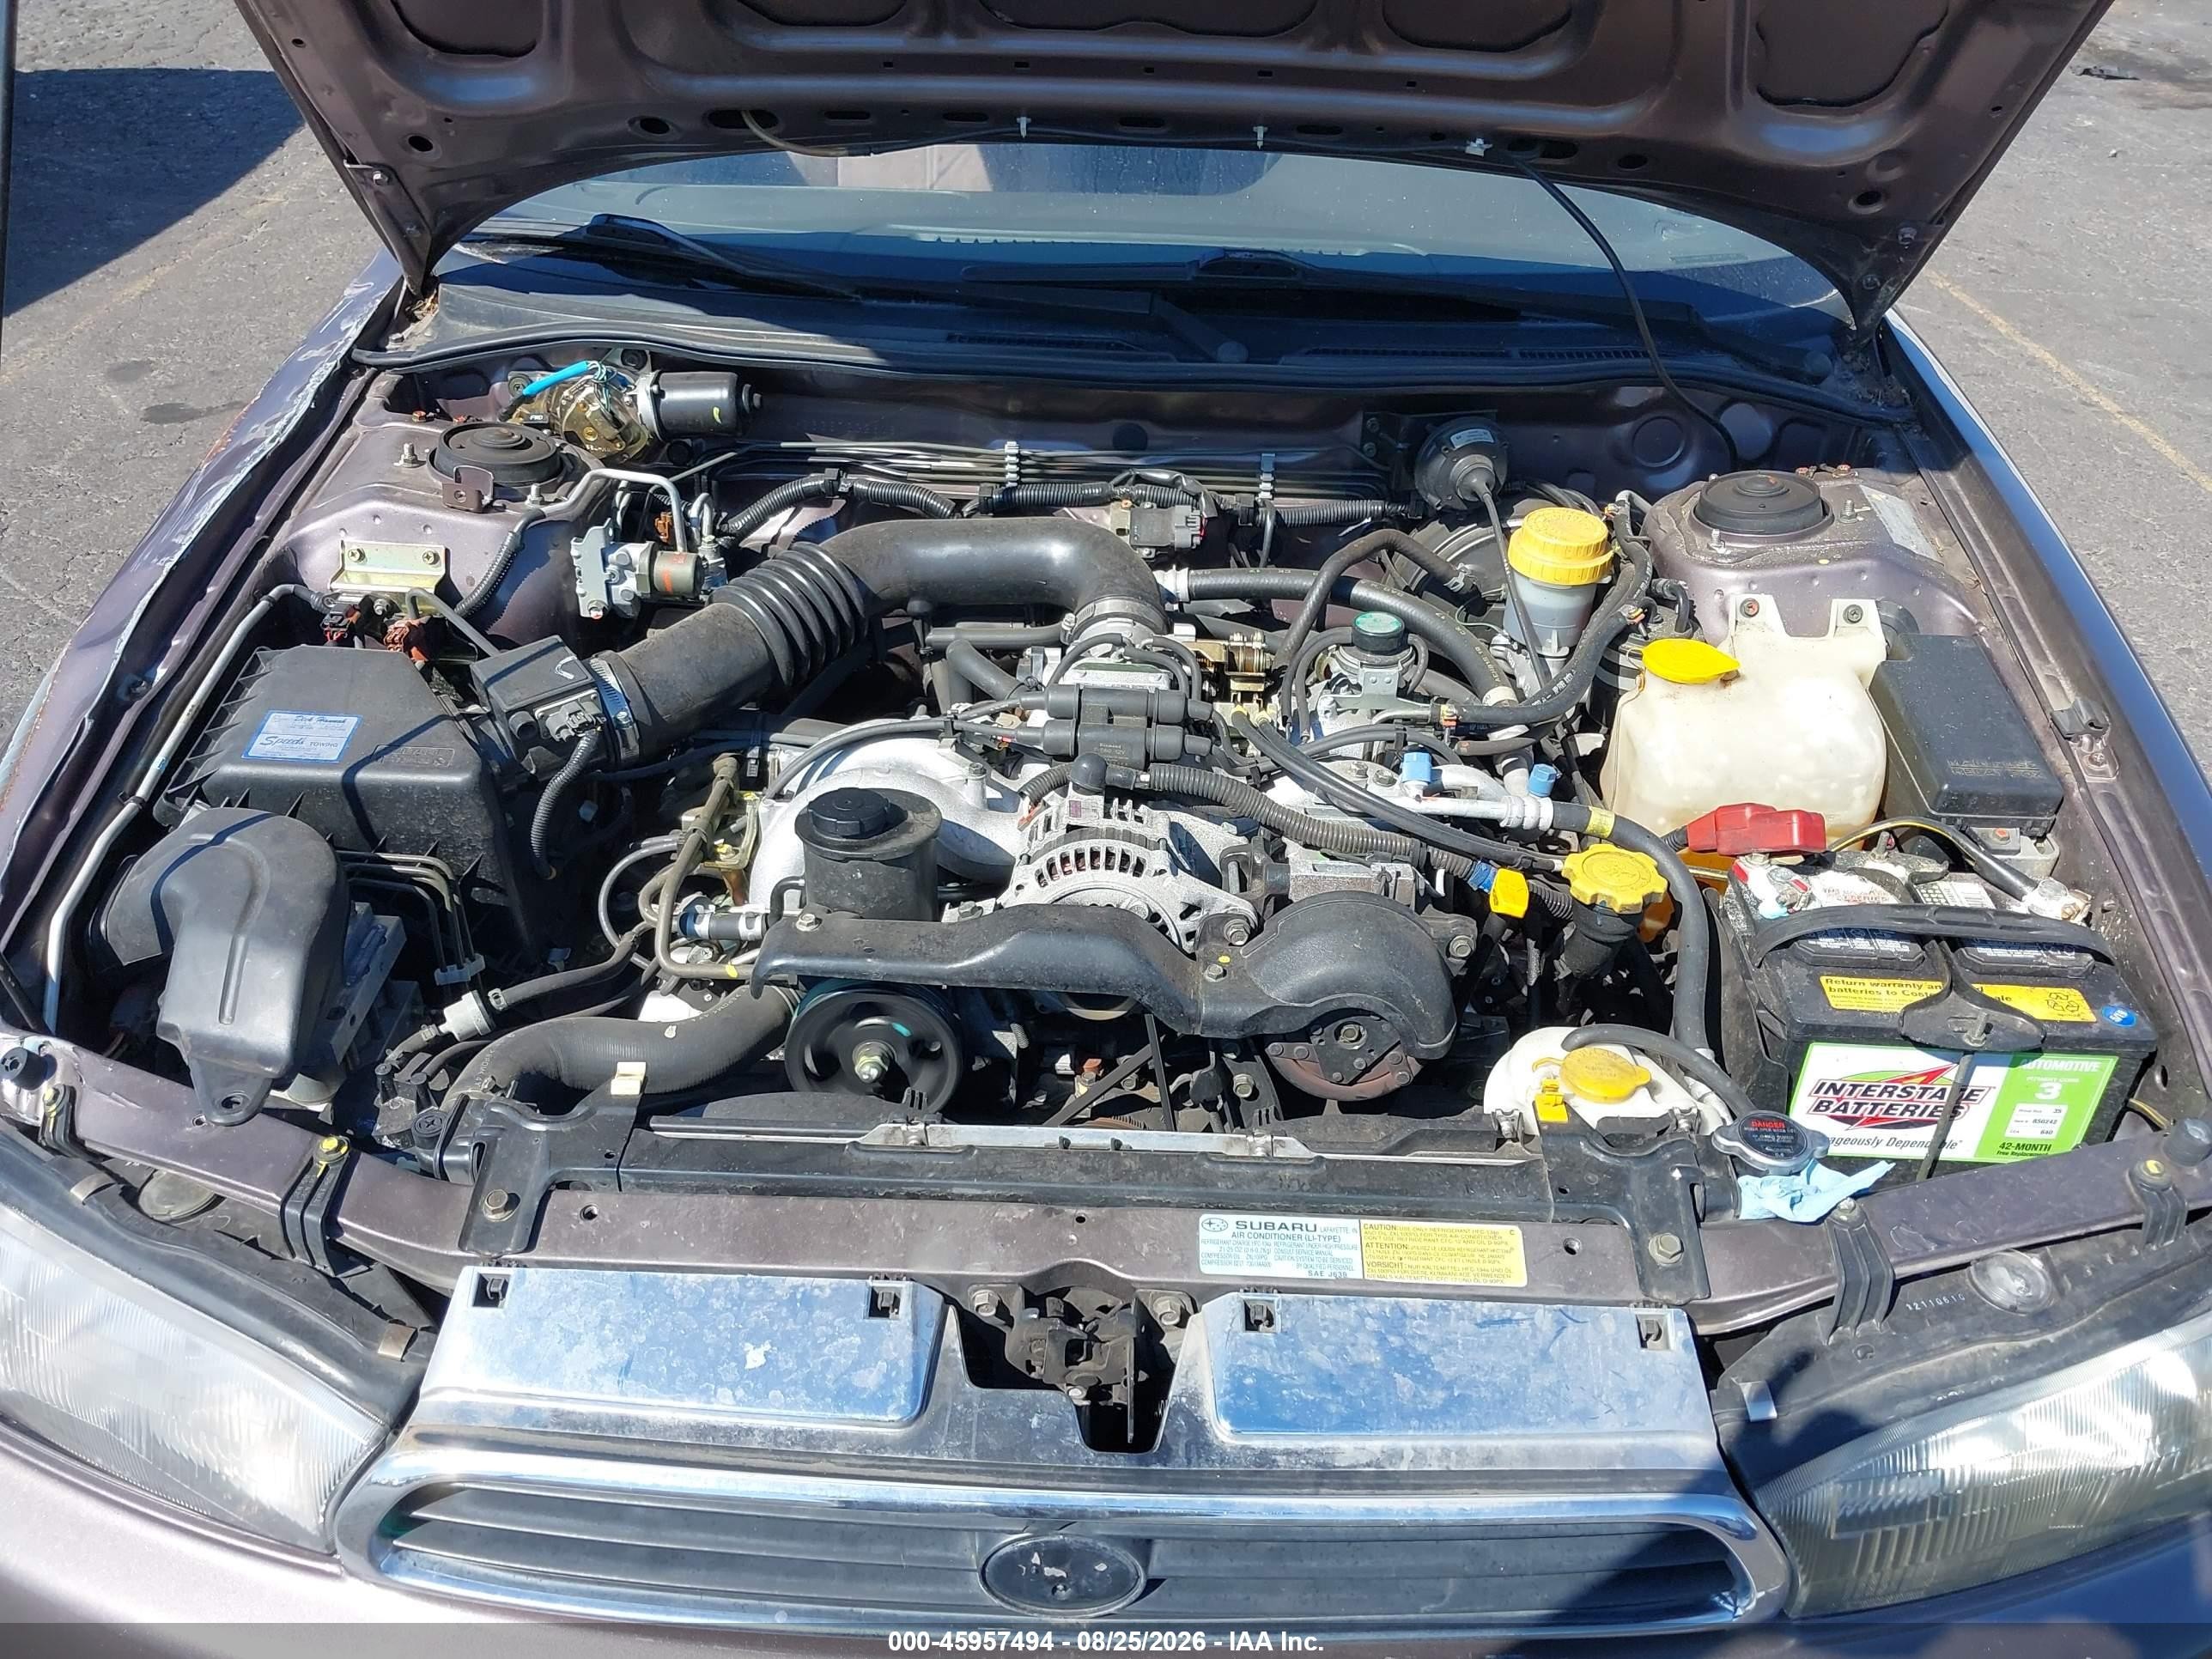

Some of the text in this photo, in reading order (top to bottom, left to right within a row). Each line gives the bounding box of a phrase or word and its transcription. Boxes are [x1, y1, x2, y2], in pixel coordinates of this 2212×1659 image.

[1826, 978, 1866, 987] Return
[1869, 981, 1923, 991] warranty
[1829, 986, 1882, 996] batteries
[1886, 988, 1898, 996] to
[2021, 1059, 2102, 1073] AUTOMOTIVE
[1814, 1081, 1984, 1103] INTERSTATE
[2034, 1082, 2063, 1100] 3
[1813, 1099, 1966, 1119] BATTERIES
[1751, 1118, 1786, 1128] DANGER
[1829, 1135, 1883, 1148] ageously
[1998, 1142, 2052, 1152] 42-MONTH
[1235, 1220, 1317, 1232] SUBARU
[1247, 1232, 1303, 1242] CONDITIONER
[1304, 1235, 1342, 1243] (LI-TYPE)
